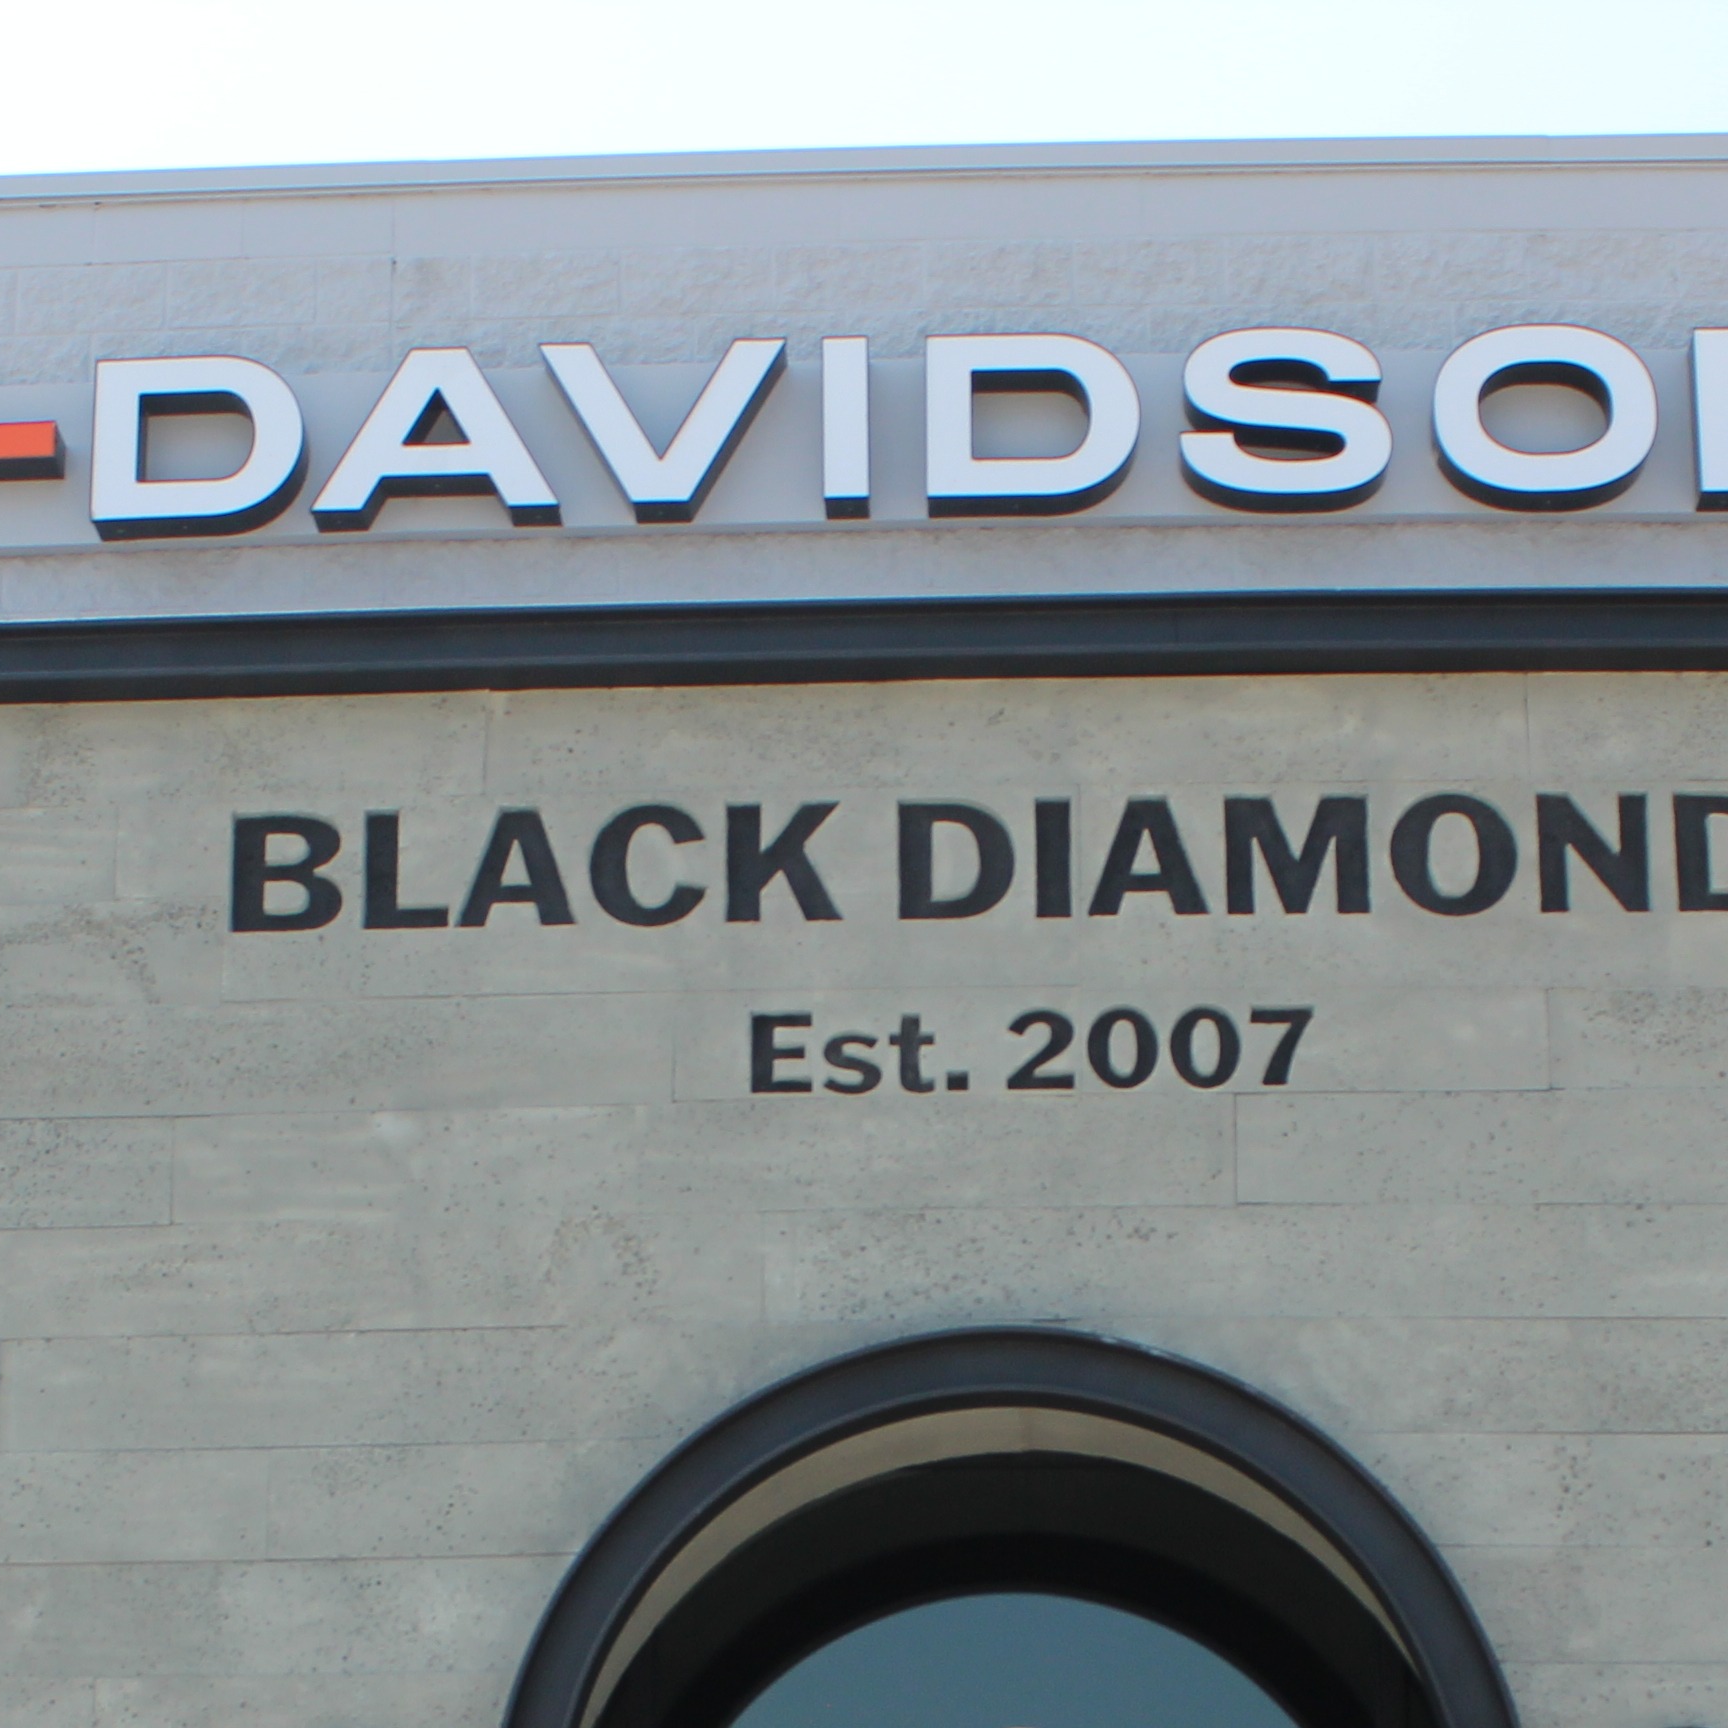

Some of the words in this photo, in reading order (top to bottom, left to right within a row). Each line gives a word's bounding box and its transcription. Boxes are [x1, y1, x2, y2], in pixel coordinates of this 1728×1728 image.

[230, 801, 844, 933] BLACK
[749, 1010, 971, 1095] Est.
[1006, 1005, 1314, 1091] 2007
